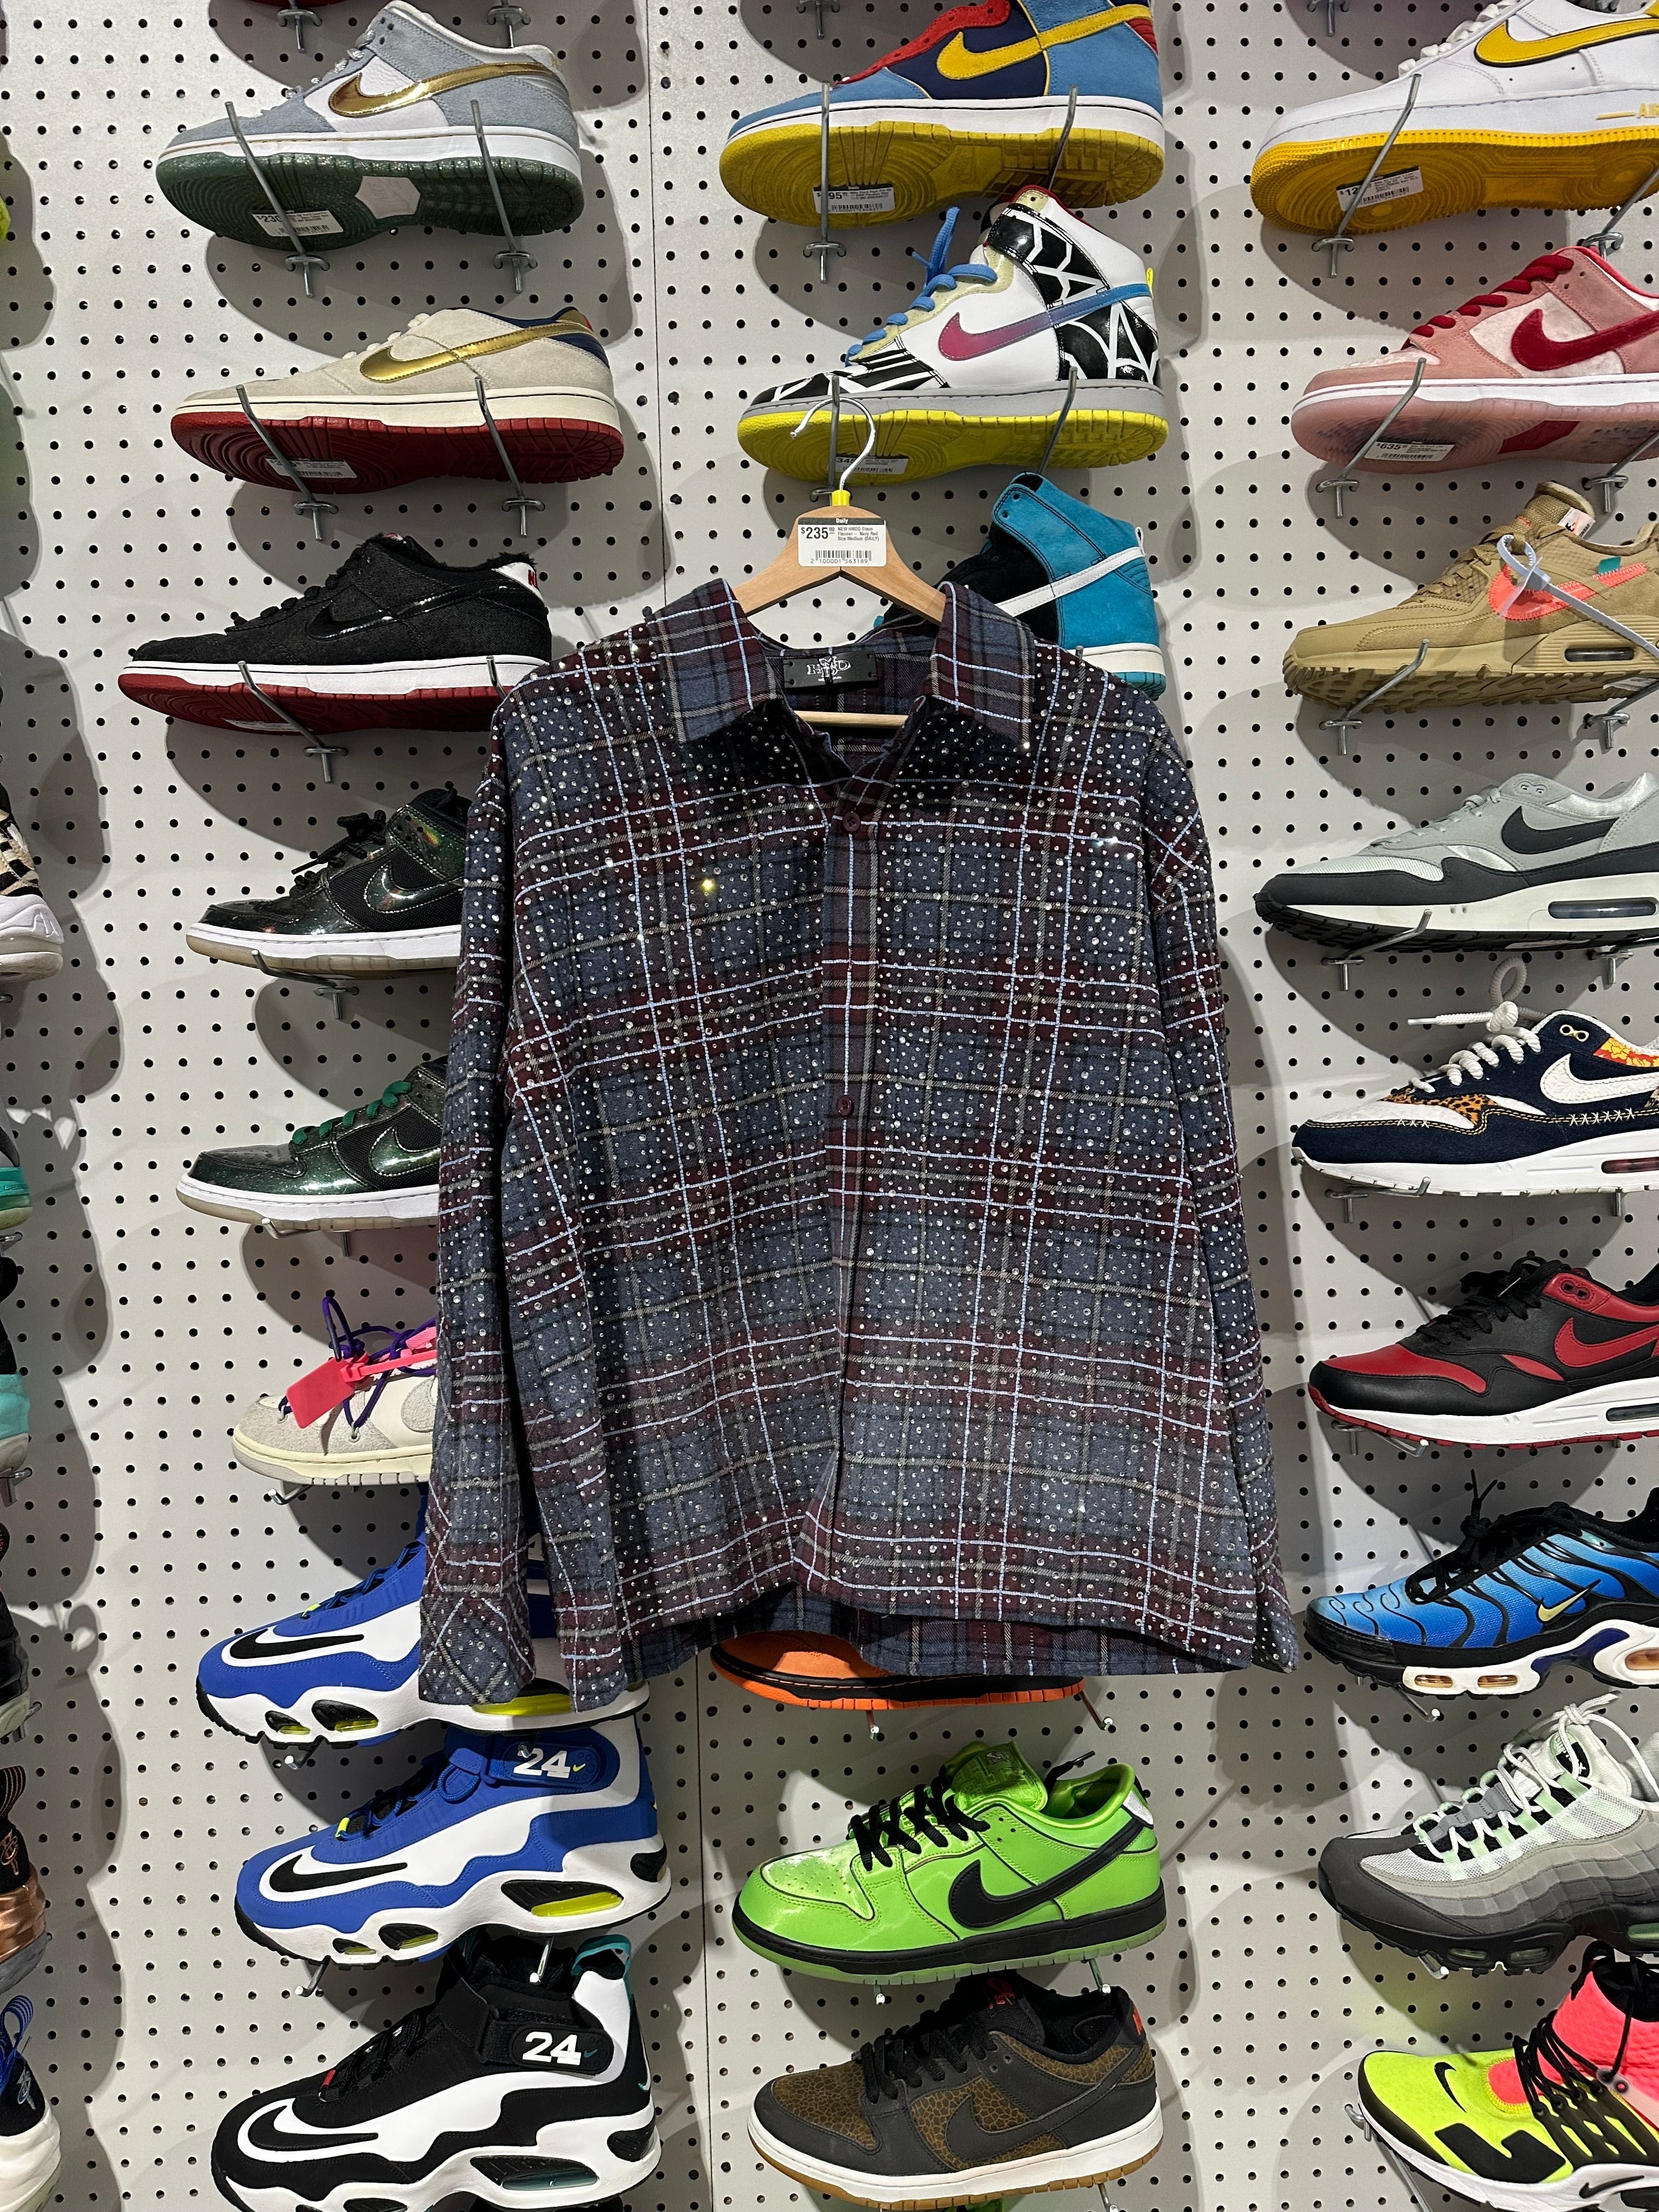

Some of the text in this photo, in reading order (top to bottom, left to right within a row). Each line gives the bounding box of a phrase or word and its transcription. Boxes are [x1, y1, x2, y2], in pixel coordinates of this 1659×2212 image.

[801, 527, 828, 539] $235
[514, 1748, 571, 1779] 24
[522, 2031, 582, 2066] 24
